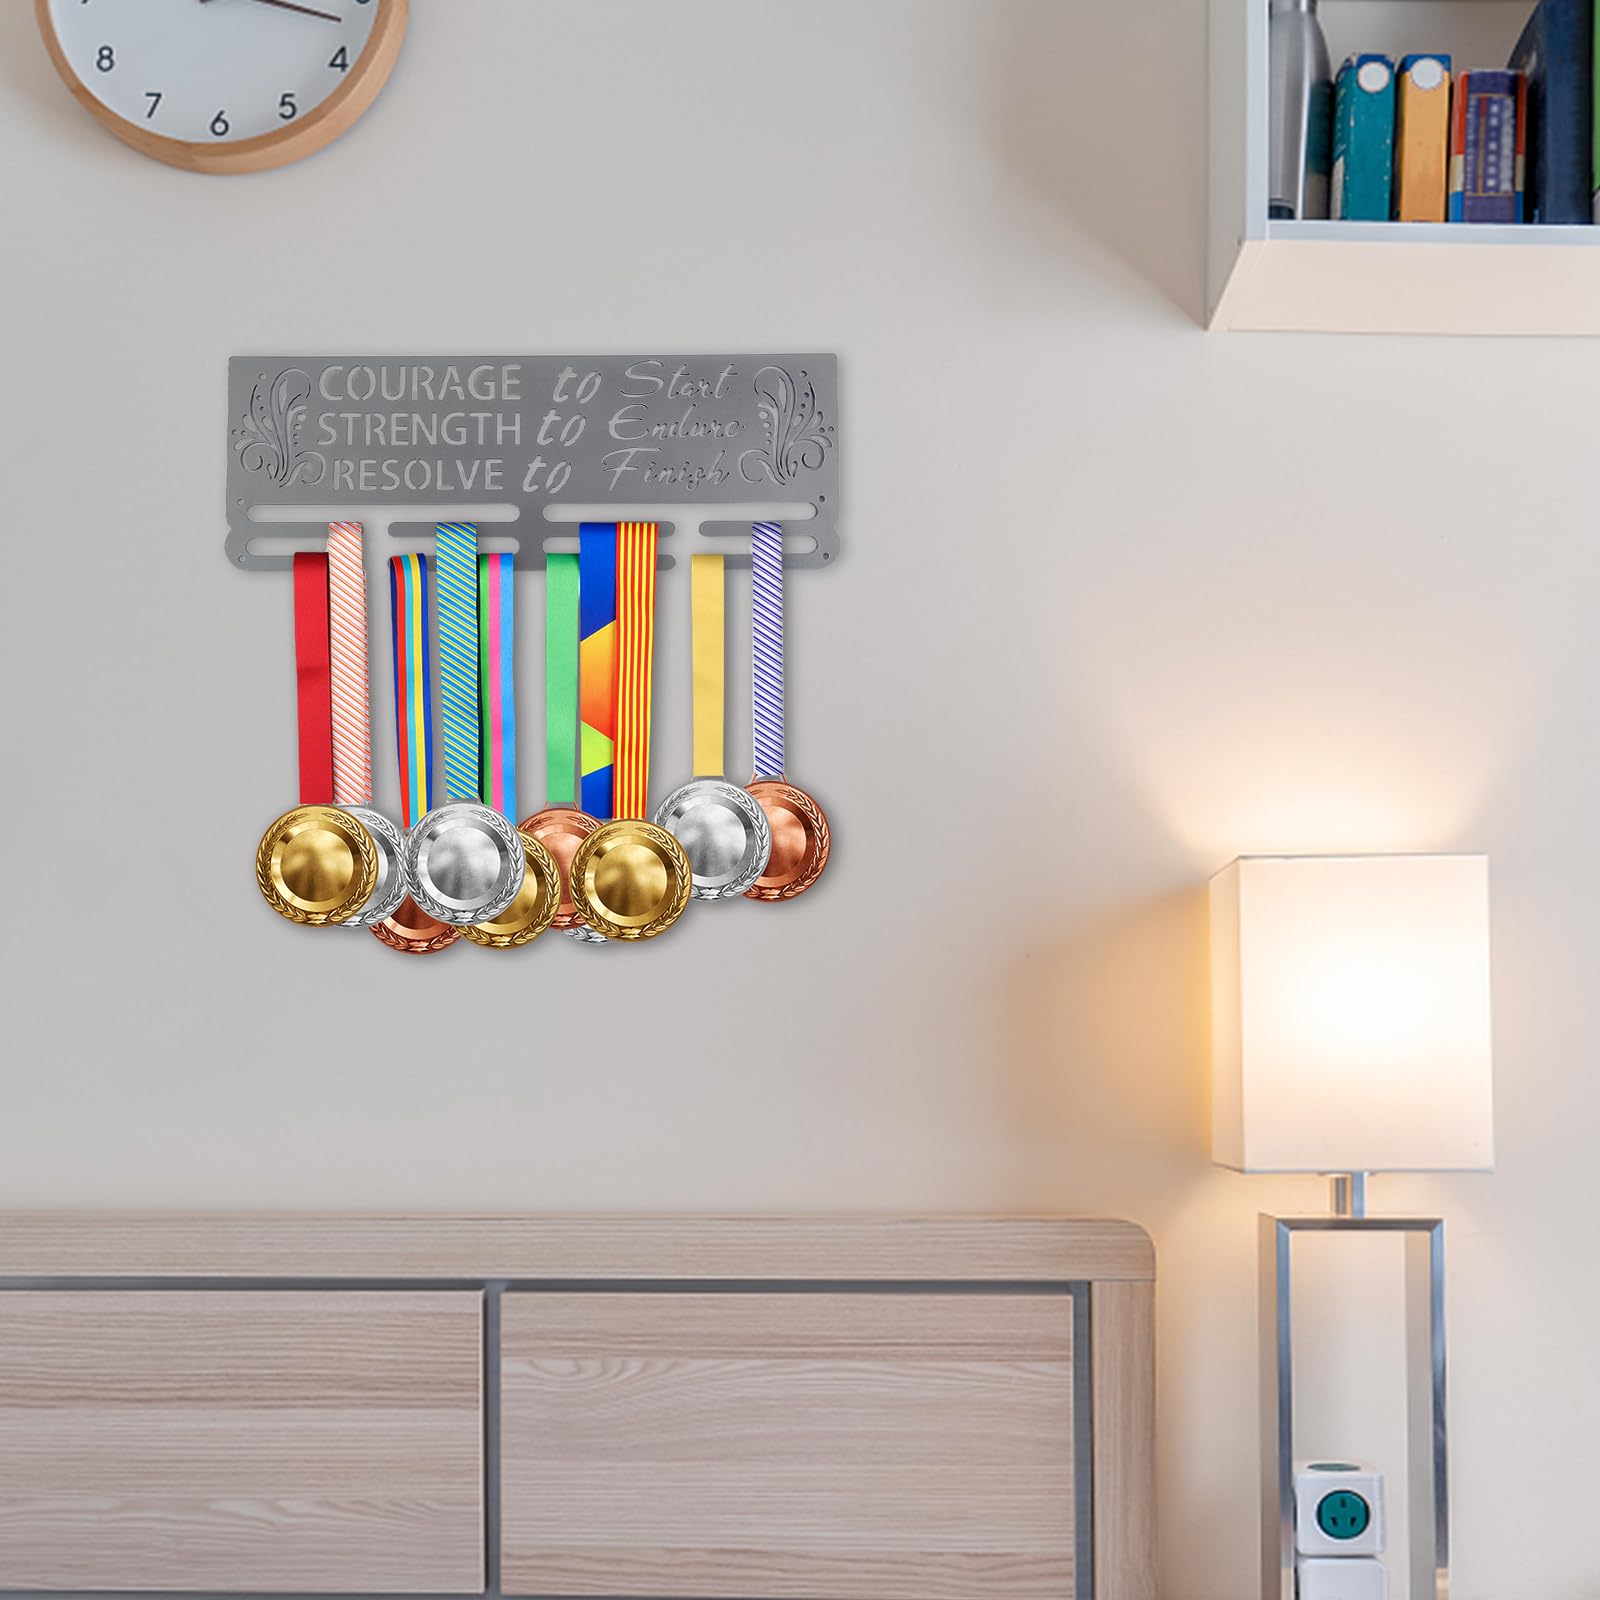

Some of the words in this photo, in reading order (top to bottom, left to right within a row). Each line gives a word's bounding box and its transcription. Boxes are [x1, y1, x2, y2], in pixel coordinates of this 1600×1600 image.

[96, 46, 115, 72] 8
[328, 46, 349, 72] 4
[145, 92, 163, 119] 7
[278, 93, 298, 120] 5
[209, 110, 230, 137] 6
[318, 364, 522, 402] COURAGE
[552, 365, 602, 404] to
[619, 359, 739, 400] Start
[316, 411, 522, 446] STRENGTH
[536, 408, 587, 447] to
[608, 403, 746, 441] Endure
[332, 458, 505, 491] RESOLVE
[522, 455, 572, 494] to
[601, 447, 731, 491] Finish
